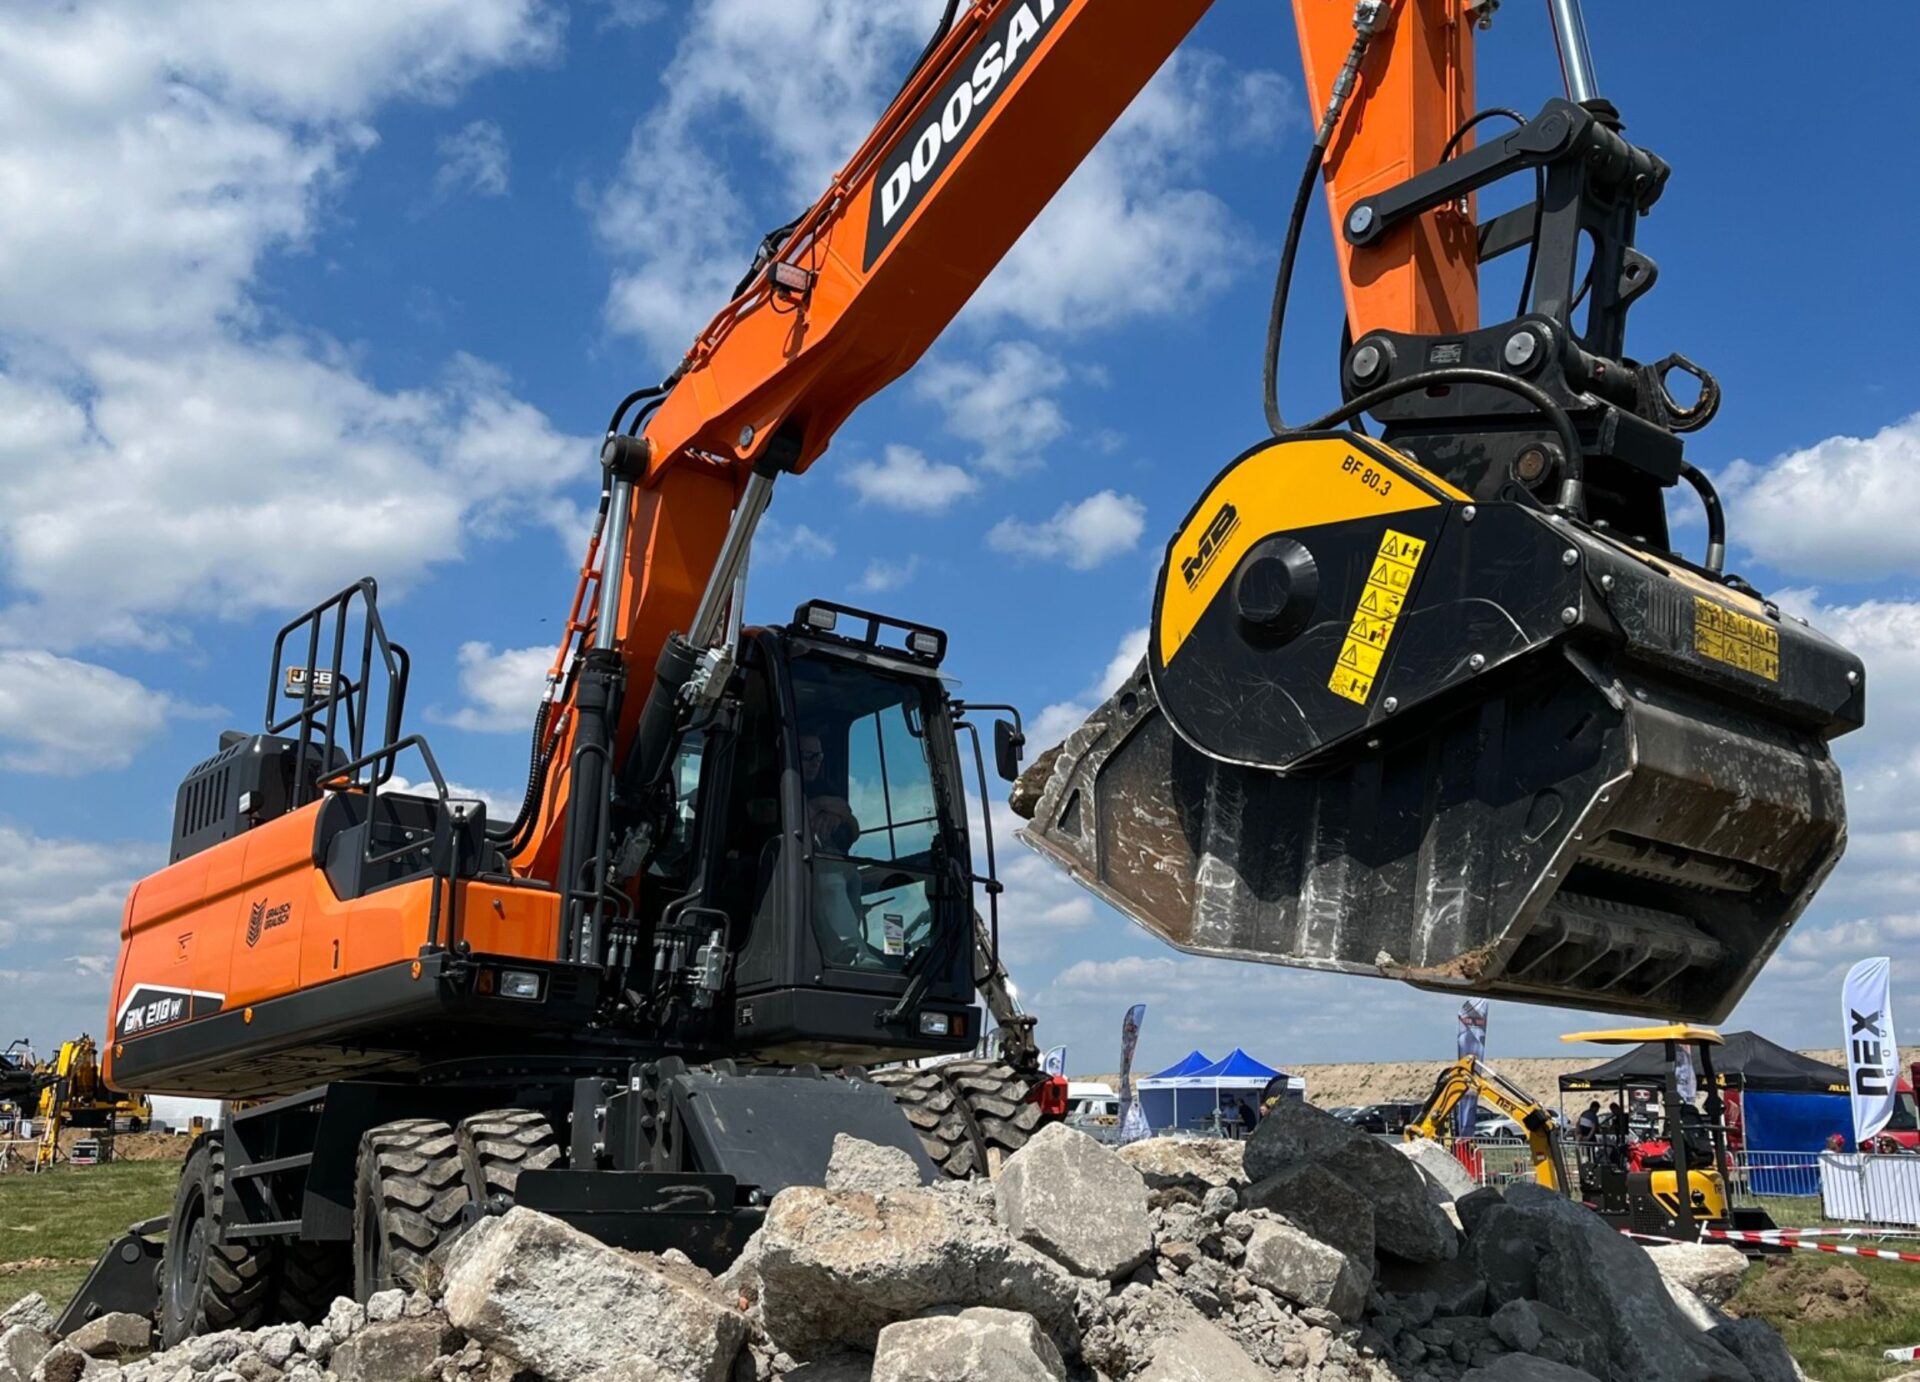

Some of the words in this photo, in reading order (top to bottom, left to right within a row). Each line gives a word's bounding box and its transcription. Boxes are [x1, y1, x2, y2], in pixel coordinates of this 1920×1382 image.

[1341, 455, 1364, 475] BF
[1361, 468, 1392, 496] 80.3
[1181, 502, 1238, 587] MB
